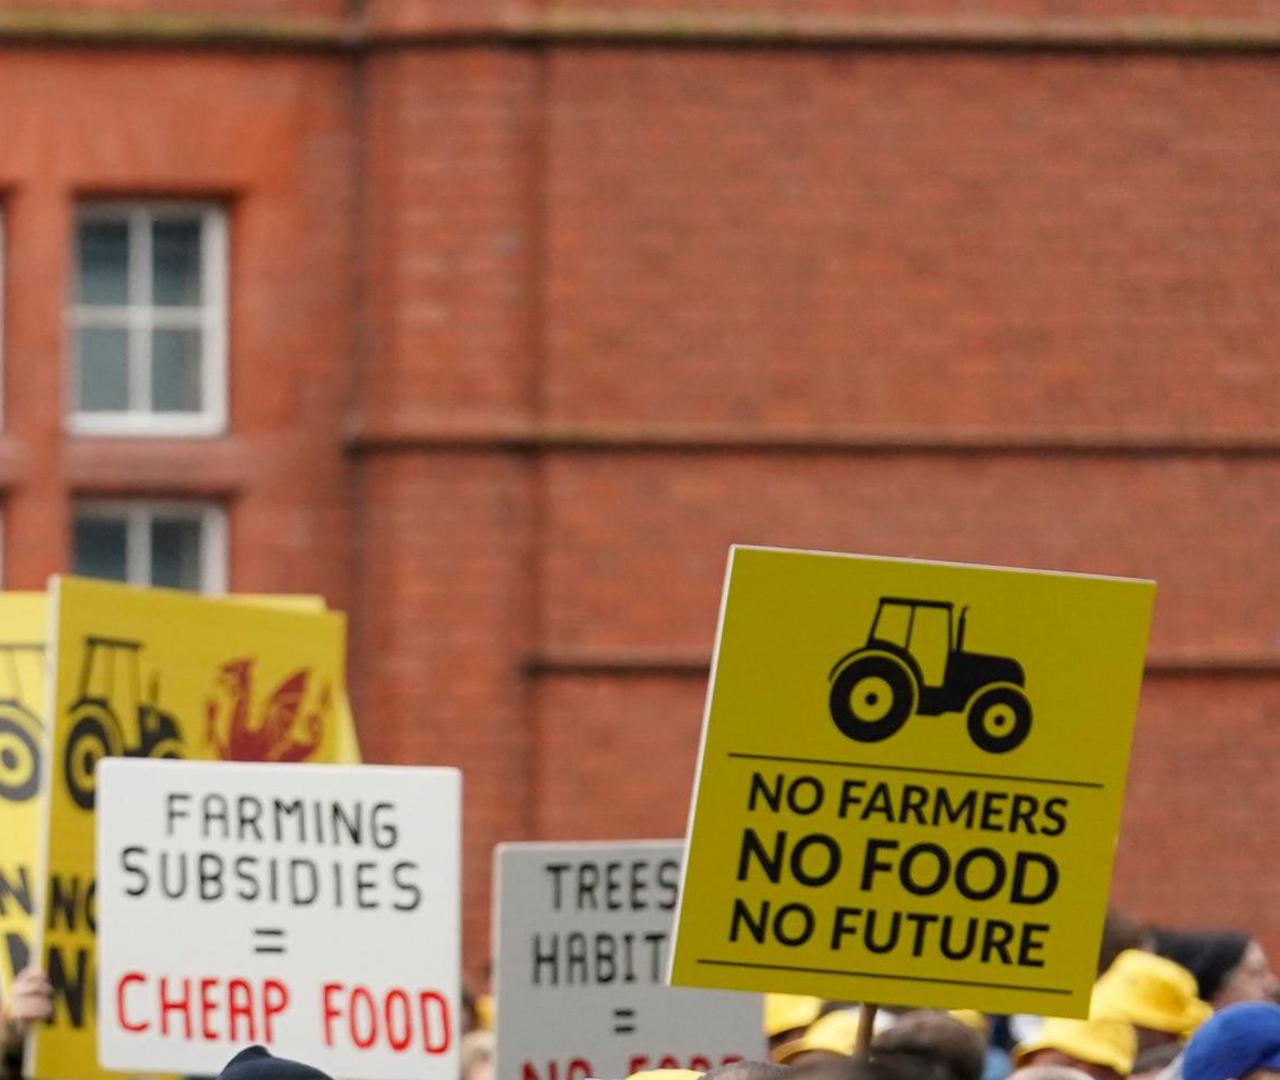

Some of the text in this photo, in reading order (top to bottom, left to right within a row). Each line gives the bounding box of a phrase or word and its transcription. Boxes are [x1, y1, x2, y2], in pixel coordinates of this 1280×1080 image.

[167, 793, 399, 849] FARMING
[746, 772, 1068, 838] NO FARMERS
[121, 846, 422, 912] SUBSIDIES
[546, 861, 679, 911] TREES
[736, 828, 1060, 905] NO FOOD
[533, 933, 667, 985] HABIT
[728, 898, 1050, 968] NO FUTURE
[115, 972, 451, 1055] CHEAP FOOD
